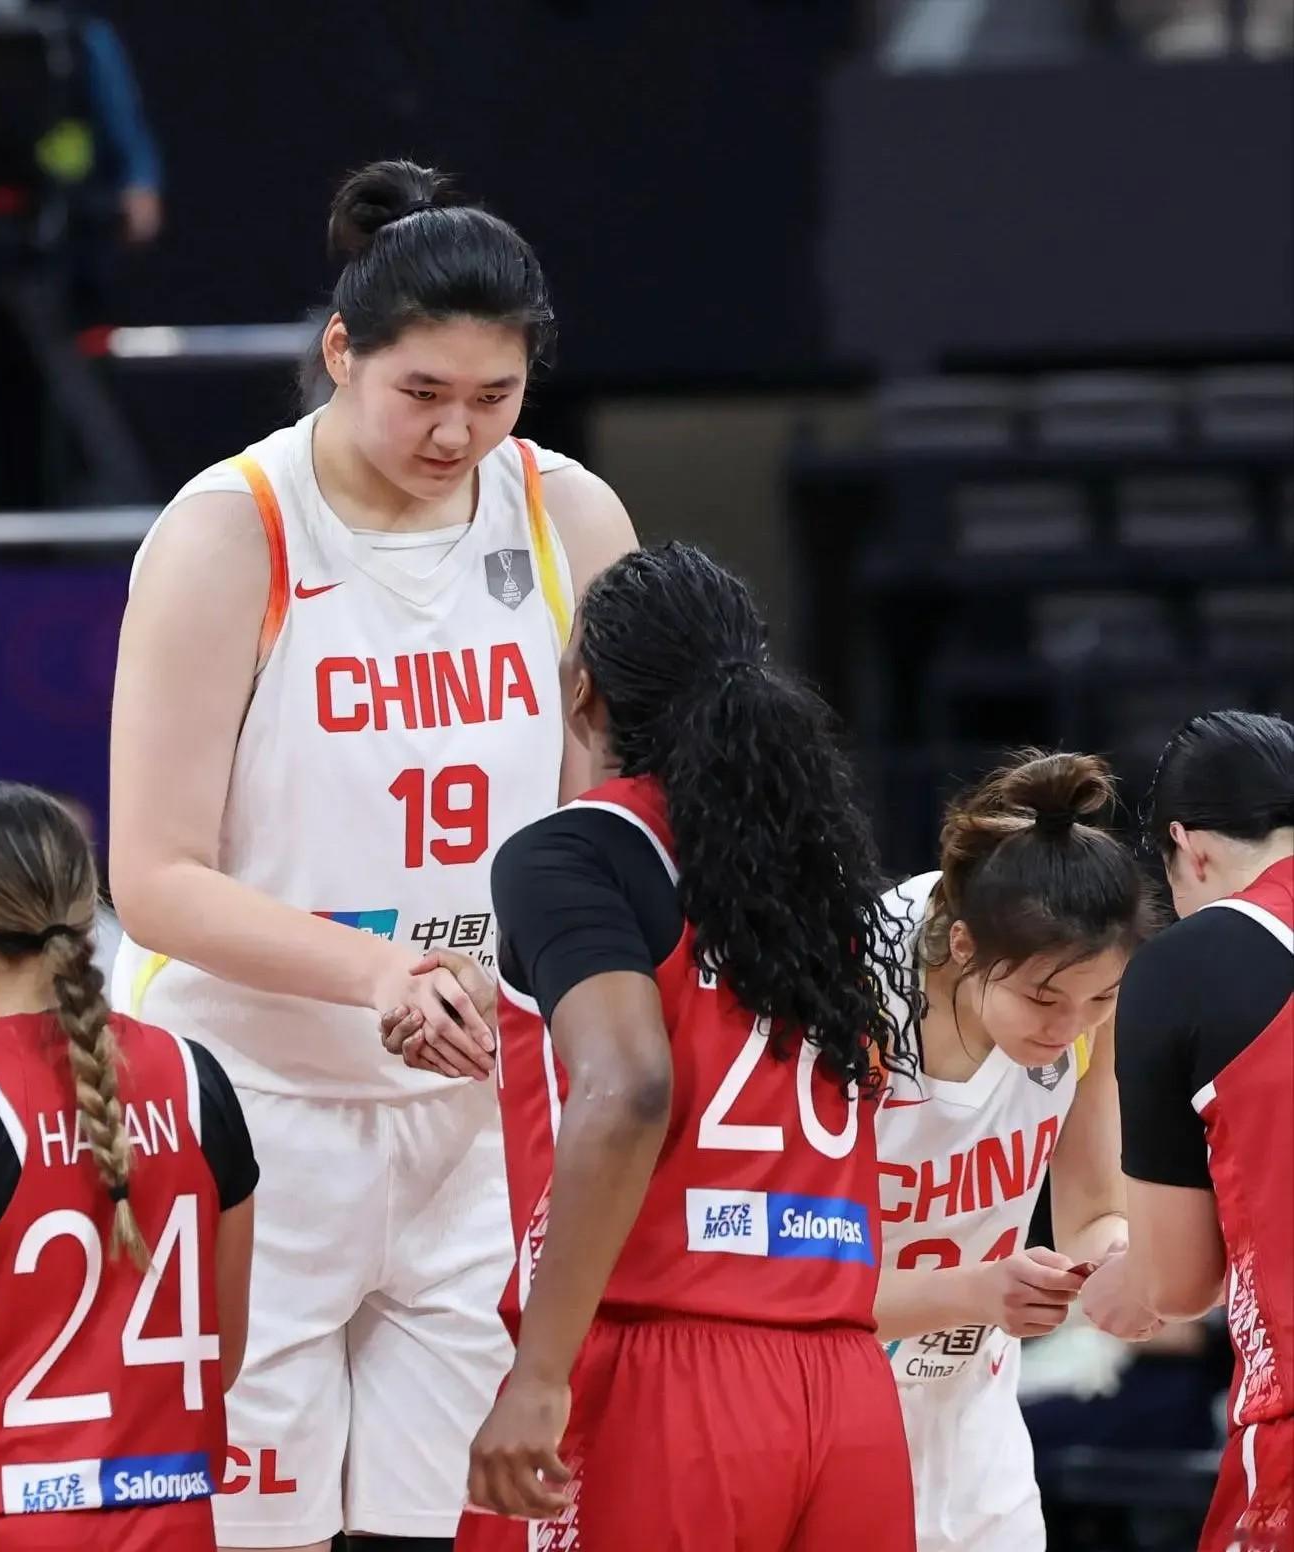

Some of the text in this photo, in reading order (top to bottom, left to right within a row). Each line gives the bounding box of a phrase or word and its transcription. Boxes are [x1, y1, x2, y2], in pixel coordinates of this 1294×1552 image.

[316, 642, 539, 733] CHINA
[389, 764, 489, 869] 19
[410, 912, 494, 950] 中国
[38, 1098, 179, 1167] HAAN
[703, 1219, 752, 1239] MOVE
[779, 1208, 863, 1247] Salonas
[3, 1193, 220, 1428] 24
[906, 1358, 954, 1378] China
[22, 1487, 86, 1514] MOVE
